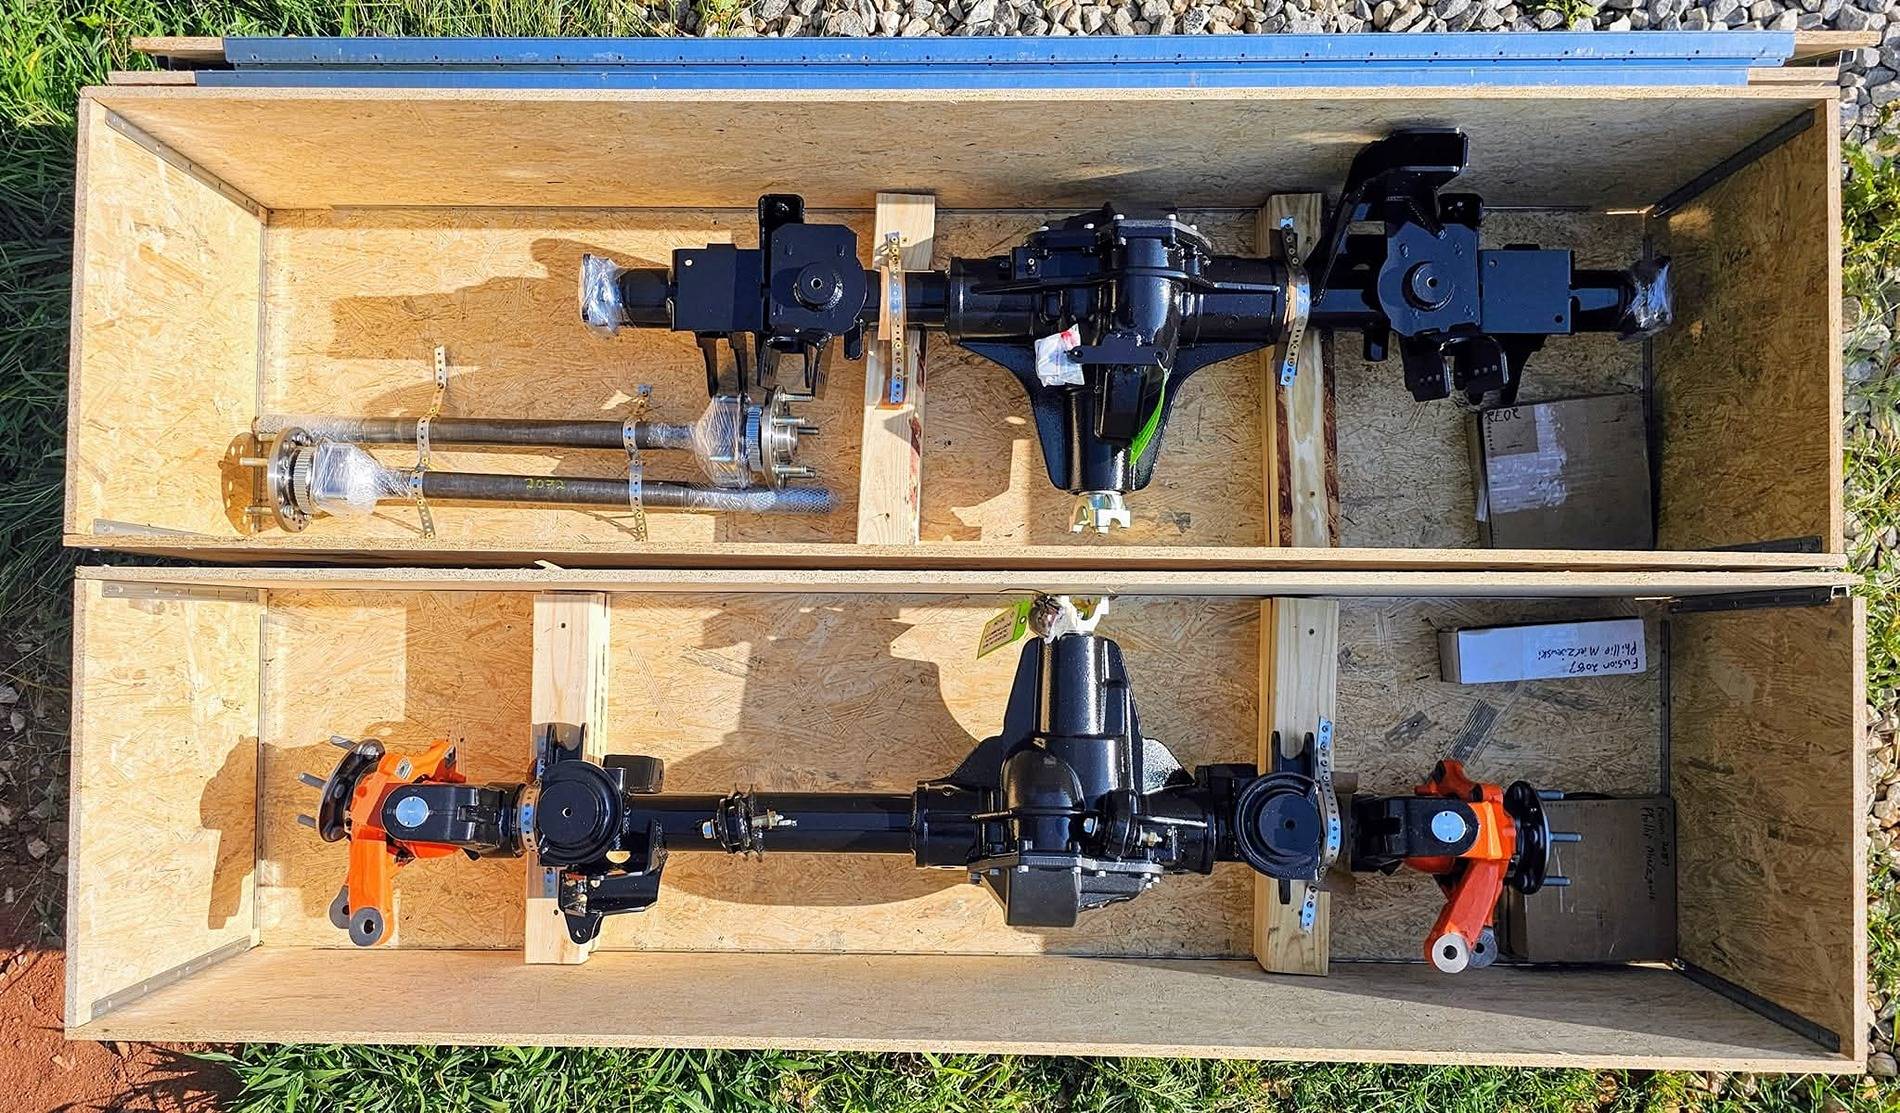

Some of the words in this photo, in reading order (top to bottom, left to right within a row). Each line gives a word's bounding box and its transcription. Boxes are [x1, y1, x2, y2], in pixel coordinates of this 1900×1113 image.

[1485, 407, 1521, 422] 2072
[524, 478, 565, 490] 2072
[1569, 660, 1599, 674] 2087
[1602, 657, 1639, 670] Fusion
